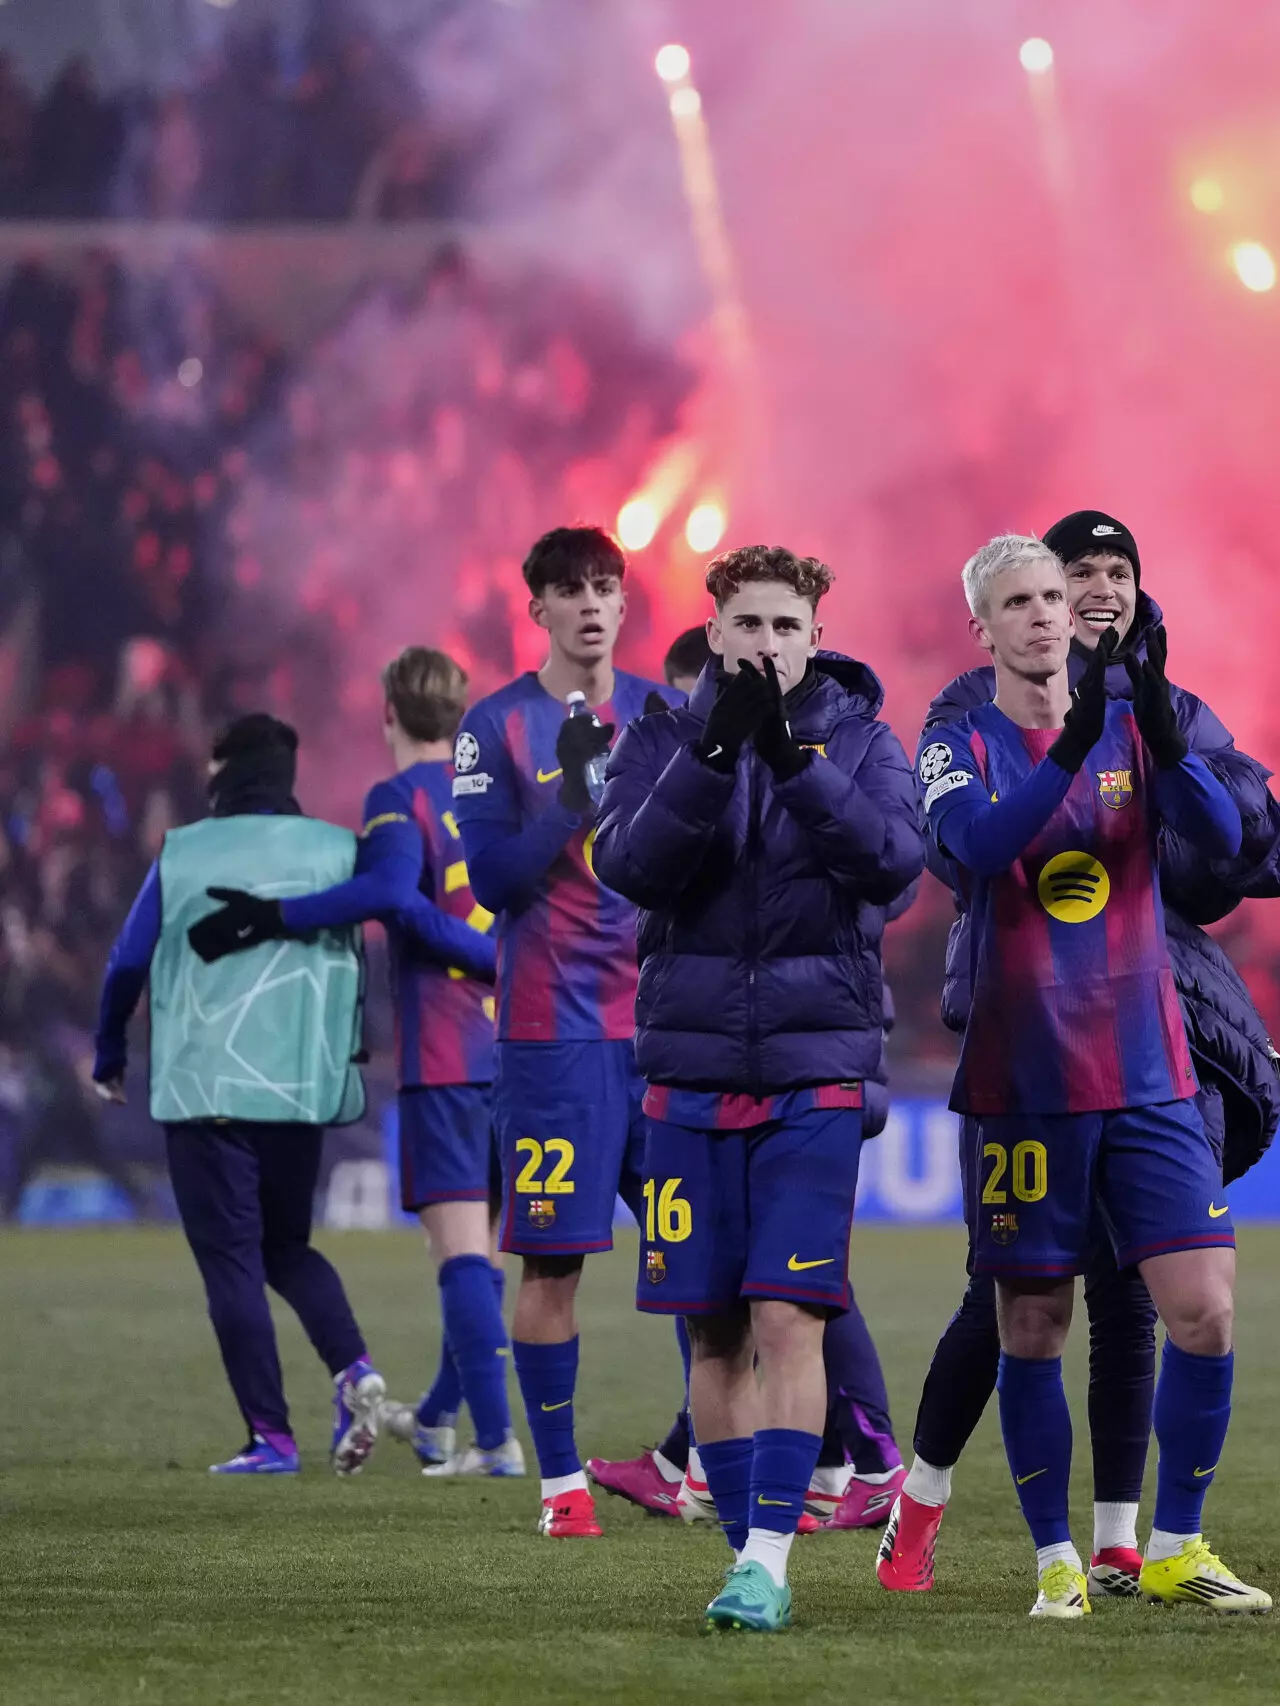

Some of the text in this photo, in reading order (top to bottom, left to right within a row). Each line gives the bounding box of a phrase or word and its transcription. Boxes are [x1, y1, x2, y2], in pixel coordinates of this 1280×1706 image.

[515, 1137, 575, 1194] 22
[982, 1140, 1048, 1204] 20
[643, 1178, 692, 1243] 16
